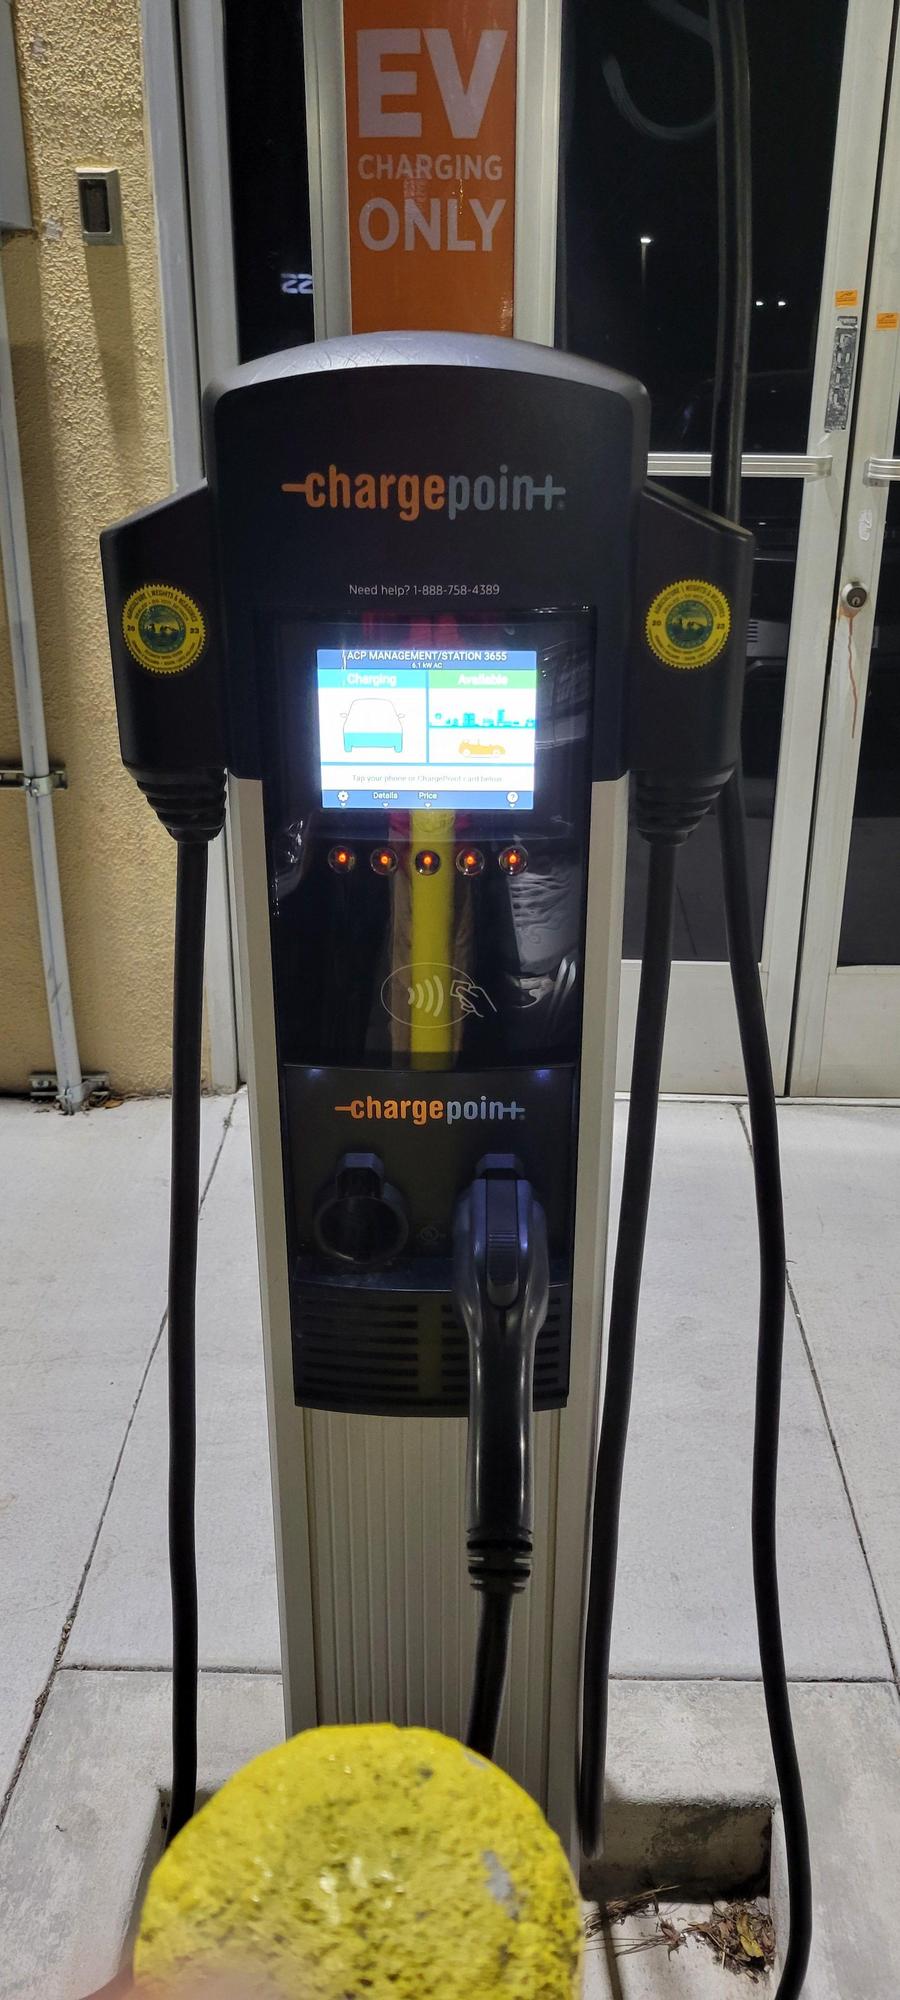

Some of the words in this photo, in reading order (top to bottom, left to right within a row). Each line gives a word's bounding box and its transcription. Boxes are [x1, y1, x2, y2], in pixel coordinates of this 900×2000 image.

[357, 28, 508, 139] EV
[358, 154, 503, 181] CHARGING
[358, 197, 506, 251] ONLY
[282, 464, 566, 521] chargepoint
[349, 585, 378, 595] Need
[381, 584, 410, 597] help?
[413, 584, 500, 596] 1-888-758-4389
[347, 651, 366, 660] ACP
[369, 651, 481, 661] MANAGEMENT/STATION
[484, 652, 507, 661] 3655
[347, 672, 397, 687] Charging
[458, 673, 508, 686] Available
[373, 791, 398, 800] Details
[418, 791, 438, 800] Price
[335, 1096, 525, 1125] chargepoint
